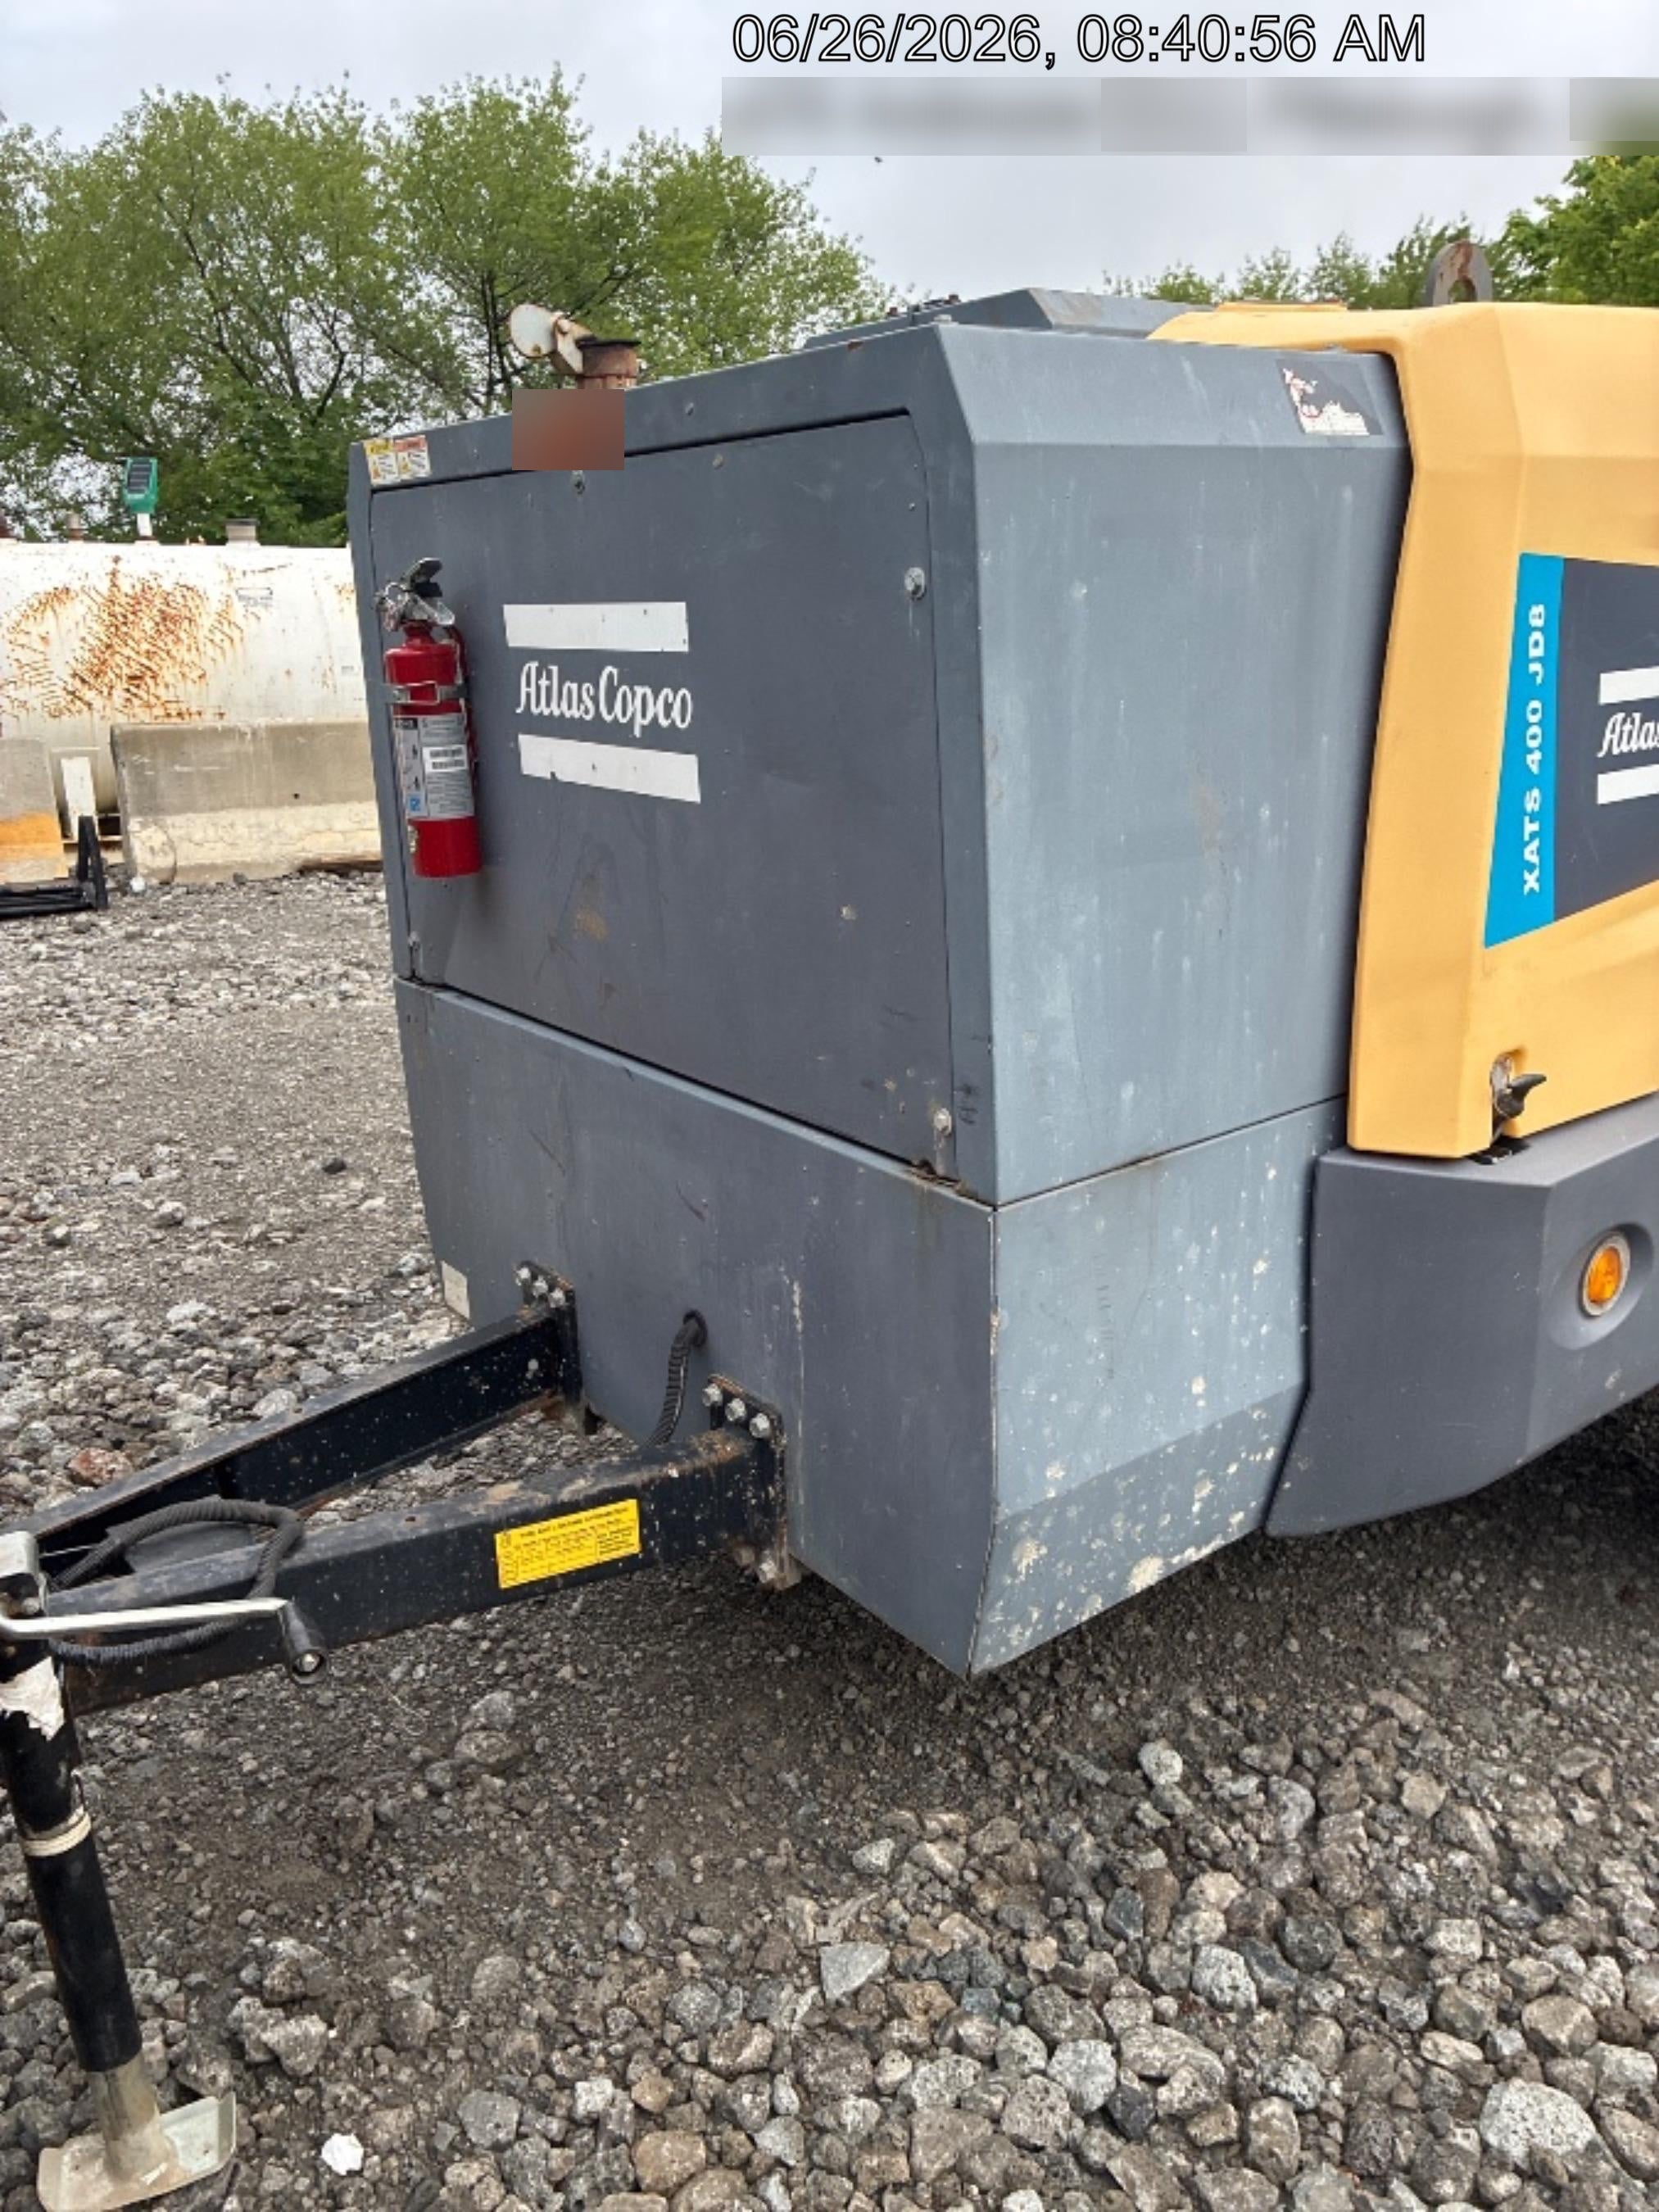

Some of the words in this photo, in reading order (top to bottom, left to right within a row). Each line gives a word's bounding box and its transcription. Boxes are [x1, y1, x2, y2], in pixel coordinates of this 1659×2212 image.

[515, 660, 596, 721] Atlas
[598, 665, 693, 737] Copco
[1526, 698, 1543, 774] 400
[1523, 787, 1541, 894] XATS
